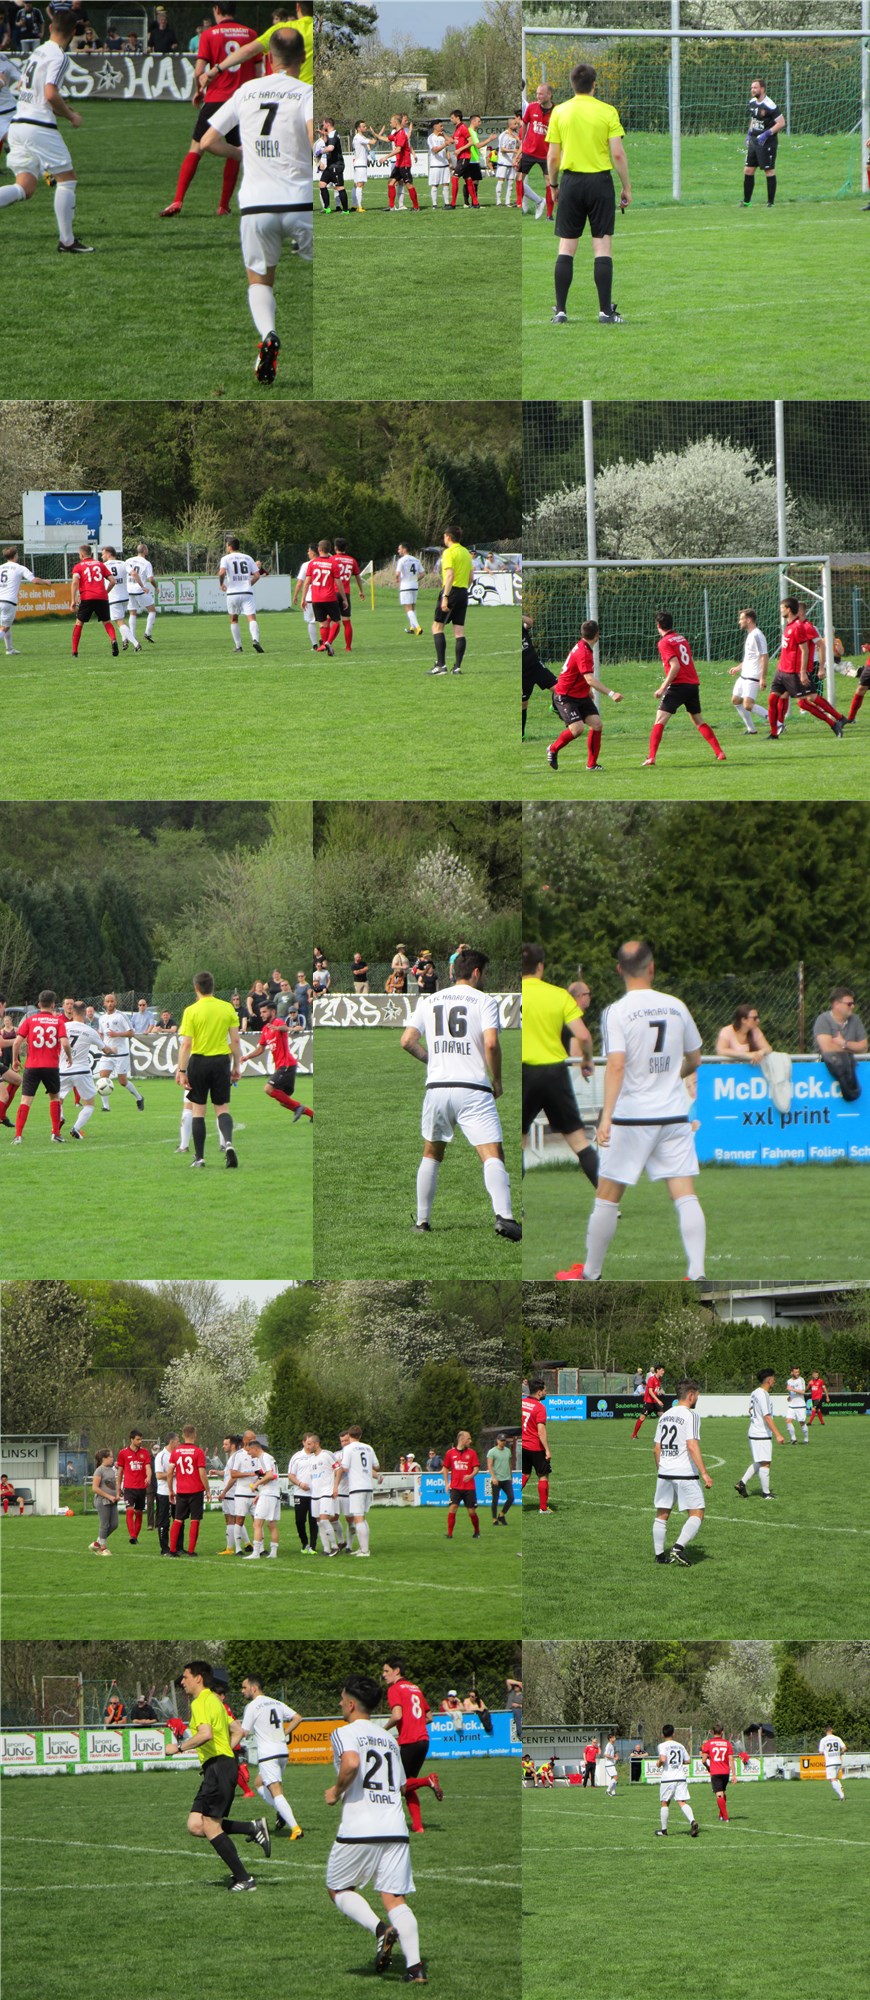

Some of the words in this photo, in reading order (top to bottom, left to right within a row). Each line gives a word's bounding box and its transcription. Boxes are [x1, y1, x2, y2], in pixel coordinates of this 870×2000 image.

[260, 102, 280, 136] 7
[84, 565, 103, 583] 13
[111, 566, 118, 577] 9
[232, 561, 249, 575] 16
[410, 563, 417, 575] 4
[312, 569, 331, 587] 27
[679, 643, 690, 666] 8
[432, 1004, 468, 1038] 16
[33, 1025, 57, 1048] 33
[69, 1035, 79, 1048] 7
[649, 1020, 667, 1053] 7
[742, 1107, 774, 1126] xxl
[780, 1106, 831, 1129] print
[715, 1148, 757, 1160] Banner
[762, 1147, 805, 1159] Fahnen
[810, 1146, 845, 1158] Folien
[660, 1424, 678, 1450] 22
[1, 1449, 39, 1458] LINSKI
[360, 1452, 367, 1468] 6
[176, 1456, 194, 1476] 13
[411, 1694, 422, 1719] 8
[269, 1708, 280, 1729] 4
[46, 1736, 78, 1755] JUNG
[89, 1735, 121, 1754] JUNG
[133, 1733, 163, 1752] JUNG
[443, 1734, 456, 1743] xxl
[460, 1732, 481, 1743] print
[522, 1736, 557, 1744] CENTER
[2, 1738, 34, 1757] JUNG
[712, 1747, 727, 1762] 27
[827, 1742, 839, 1752] 29
[669, 1750, 682, 1765] 21
[363, 1748, 396, 1792] 21
[369, 1791, 396, 1805] ÜNAL
